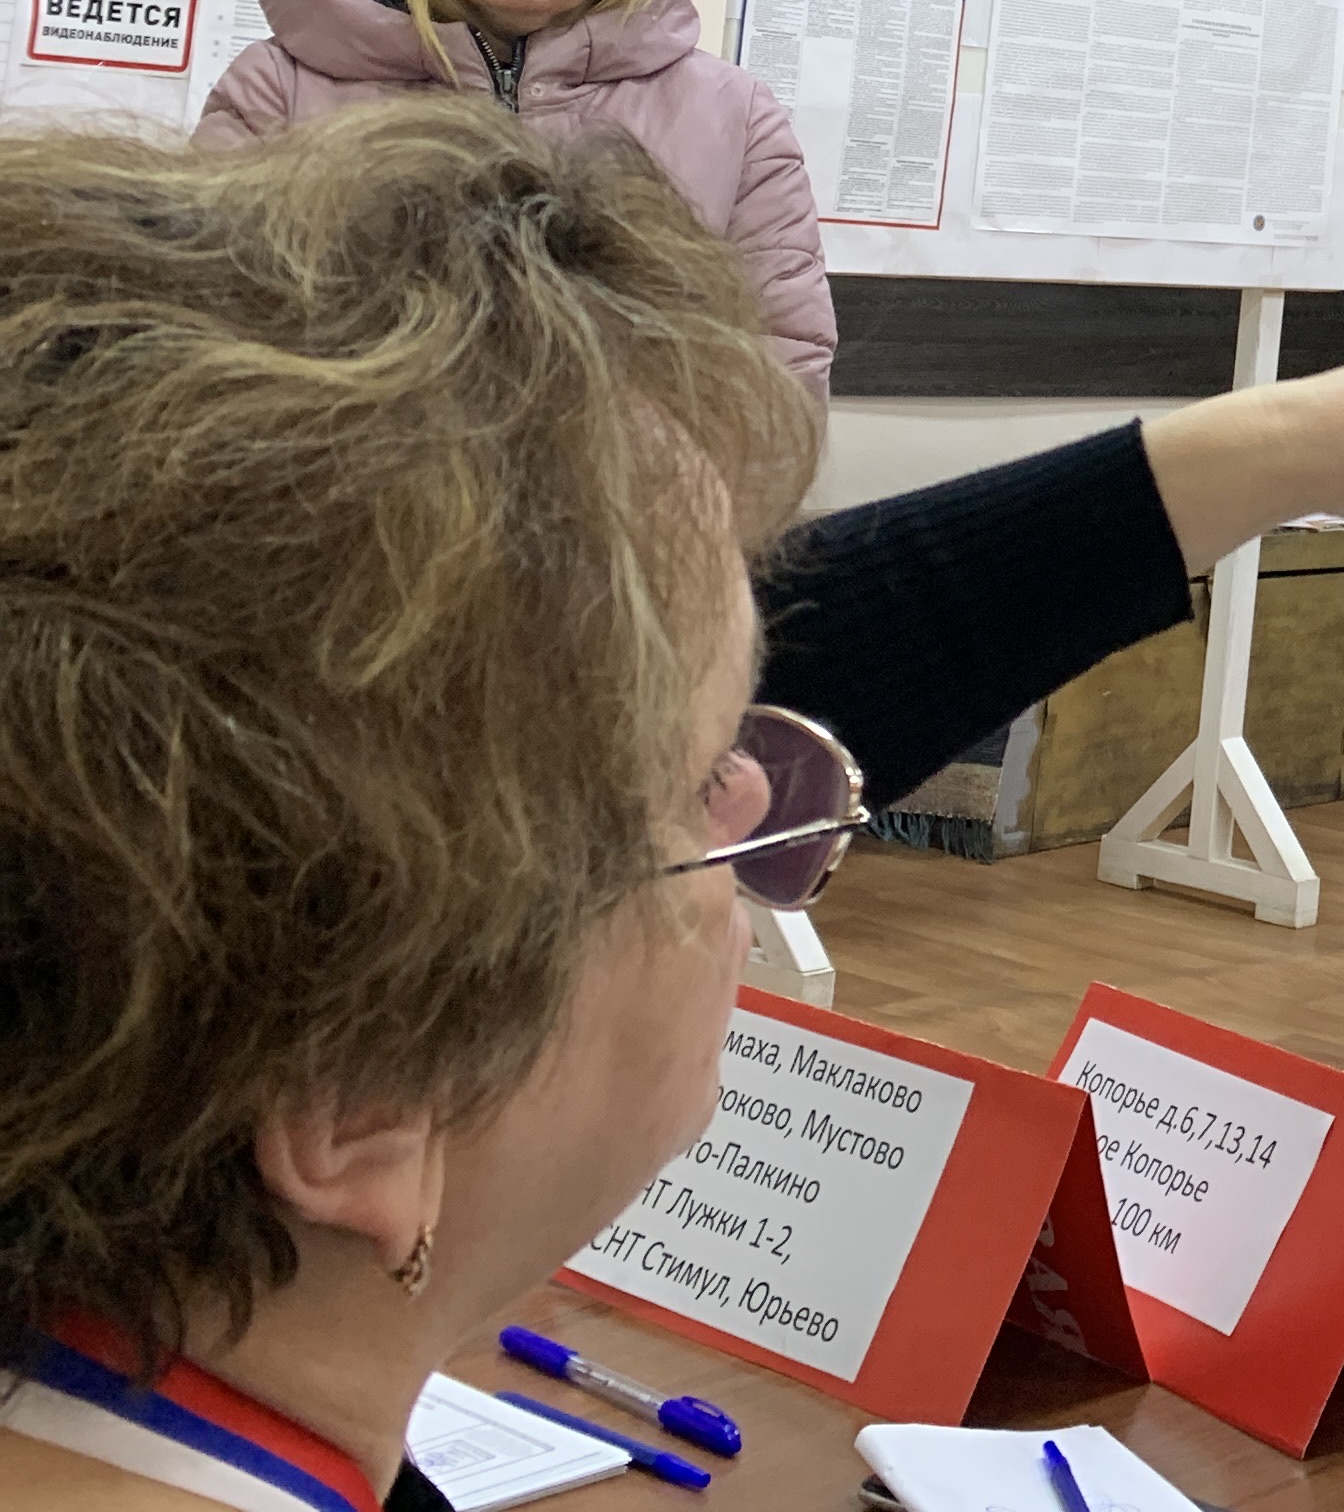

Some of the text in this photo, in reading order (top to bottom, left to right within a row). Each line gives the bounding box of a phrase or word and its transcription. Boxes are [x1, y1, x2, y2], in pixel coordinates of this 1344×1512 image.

[42, 26, 179, 49] ВИДЕОНАБЛЮДЕНИЕ
[722, 1030, 924, 1114] маха, Маклаково
[718, 1085, 905, 1170] оково, Мустово
[1075, 1060, 1278, 1170] Копорье д.6,7,13,14
[685, 1140, 821, 1204] о-Палкино
[1096, 1134, 1209, 1203] ое Копорье
[665, 1187, 748, 1242] Лужки
[749, 1217, 793, 1264] 1-2,
[1147, 1222, 1182, 1255] км
[641, 1241, 732, 1308] Стимул,
[738, 1277, 840, 1343] Юрьево
